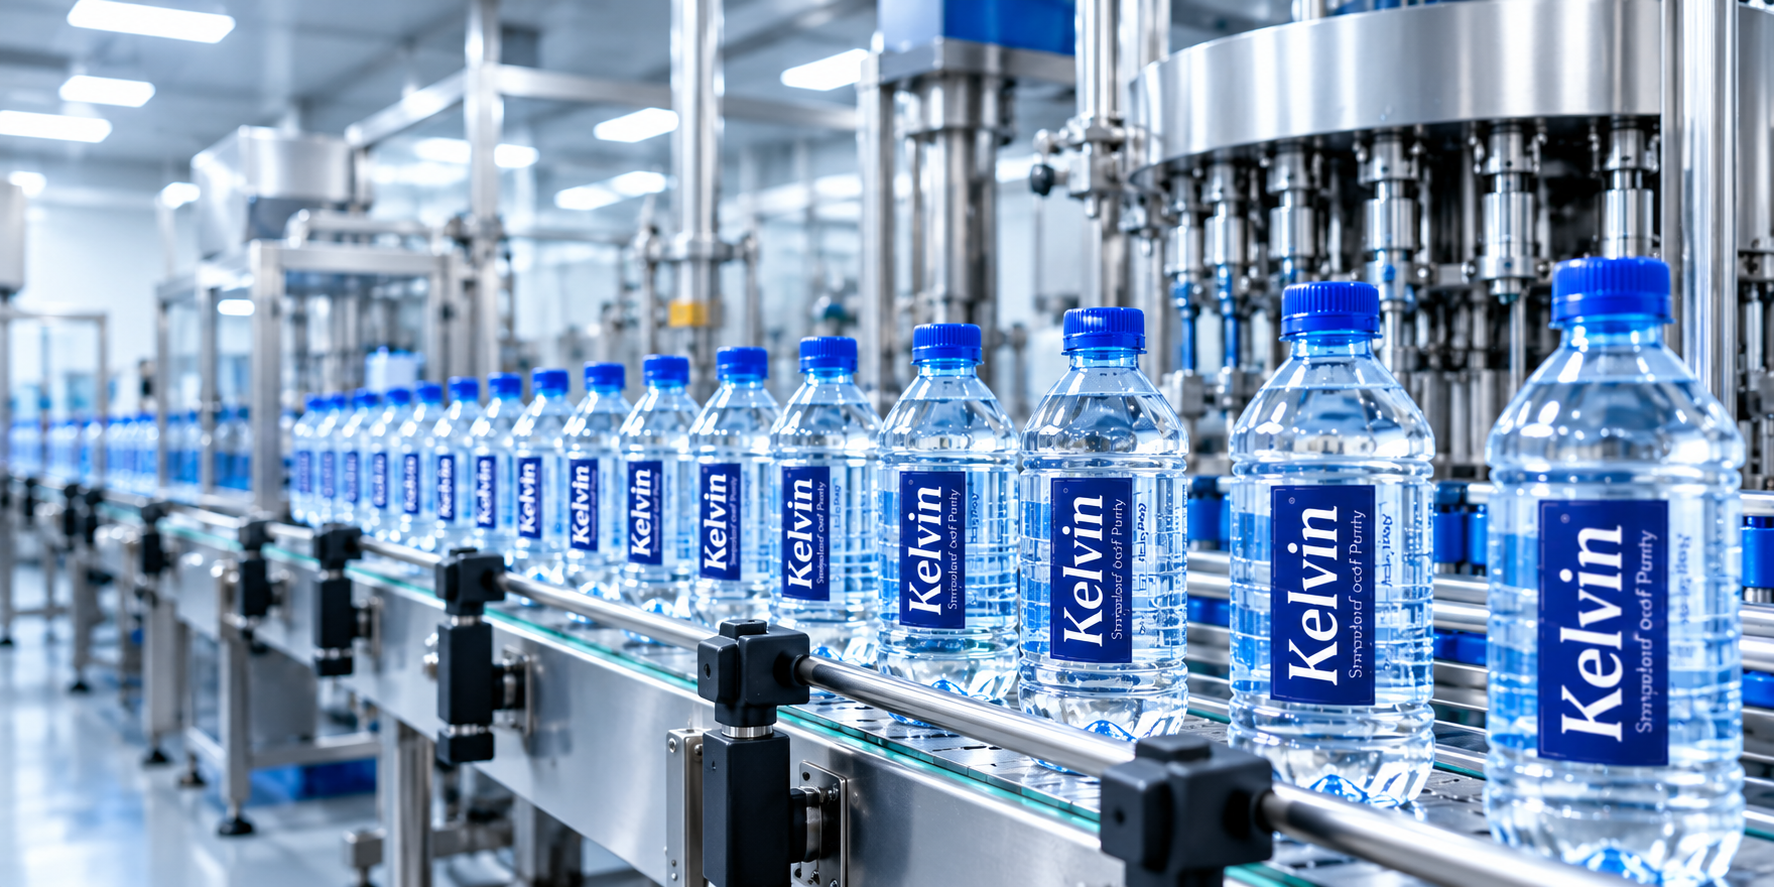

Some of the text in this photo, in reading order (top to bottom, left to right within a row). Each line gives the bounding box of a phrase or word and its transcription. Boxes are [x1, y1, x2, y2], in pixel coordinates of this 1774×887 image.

[519, 463, 536, 533] Kelvin
[571, 465, 590, 545] Kelvin
[630, 468, 651, 557] Kelvin
[703, 473, 727, 571] Kelvin
[787, 478, 812, 589] Kelvin
[908, 486, 942, 616] Kelvin
[1062, 495, 1104, 647] Kelvin
[1287, 505, 1338, 686] Kelvin
[1559, 525, 1624, 742] Kelvin
